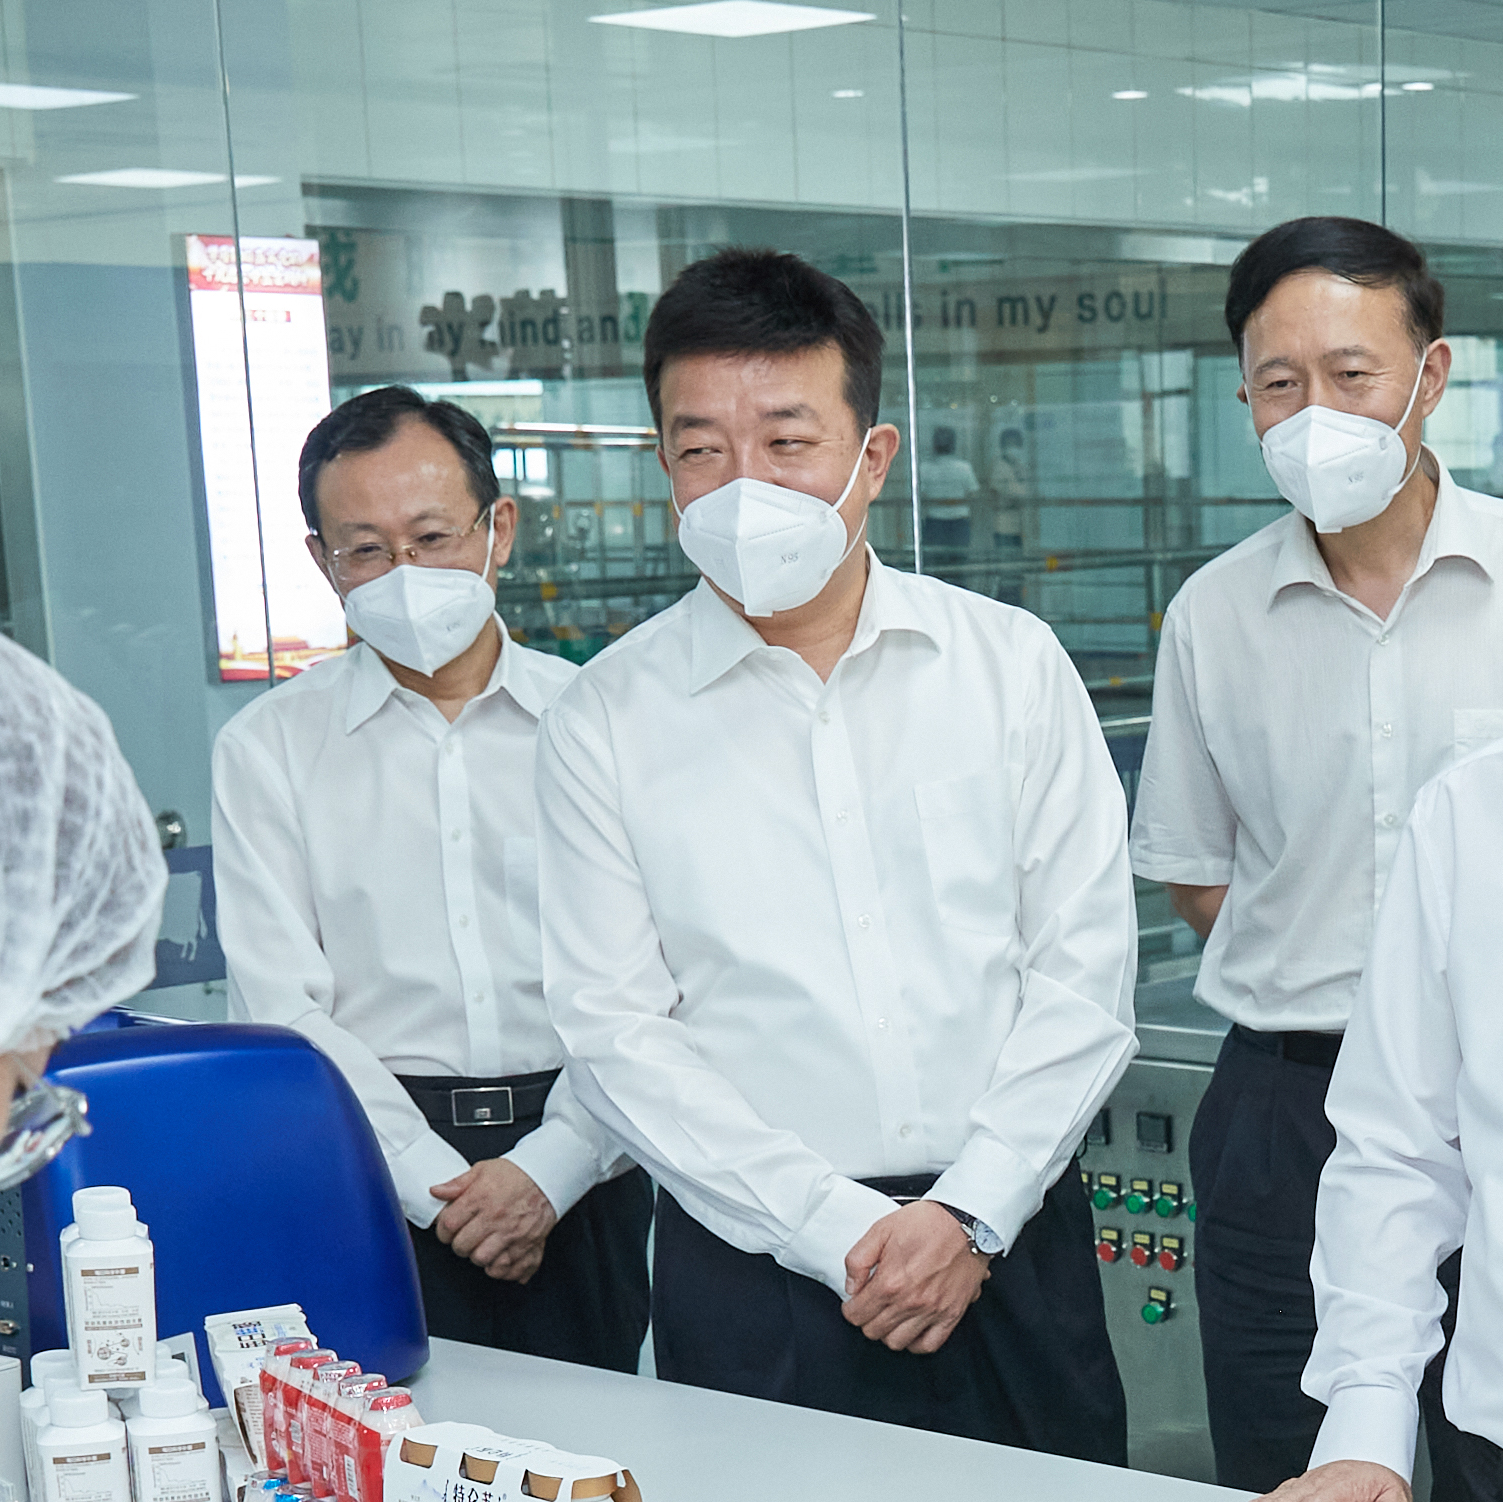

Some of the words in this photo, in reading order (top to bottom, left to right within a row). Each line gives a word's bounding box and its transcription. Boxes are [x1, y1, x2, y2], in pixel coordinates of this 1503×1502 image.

[941, 289, 976, 328] in
[997, 294, 1056, 334] my
[1076, 275, 1167, 323] soul
[780, 551, 799, 565] N95
